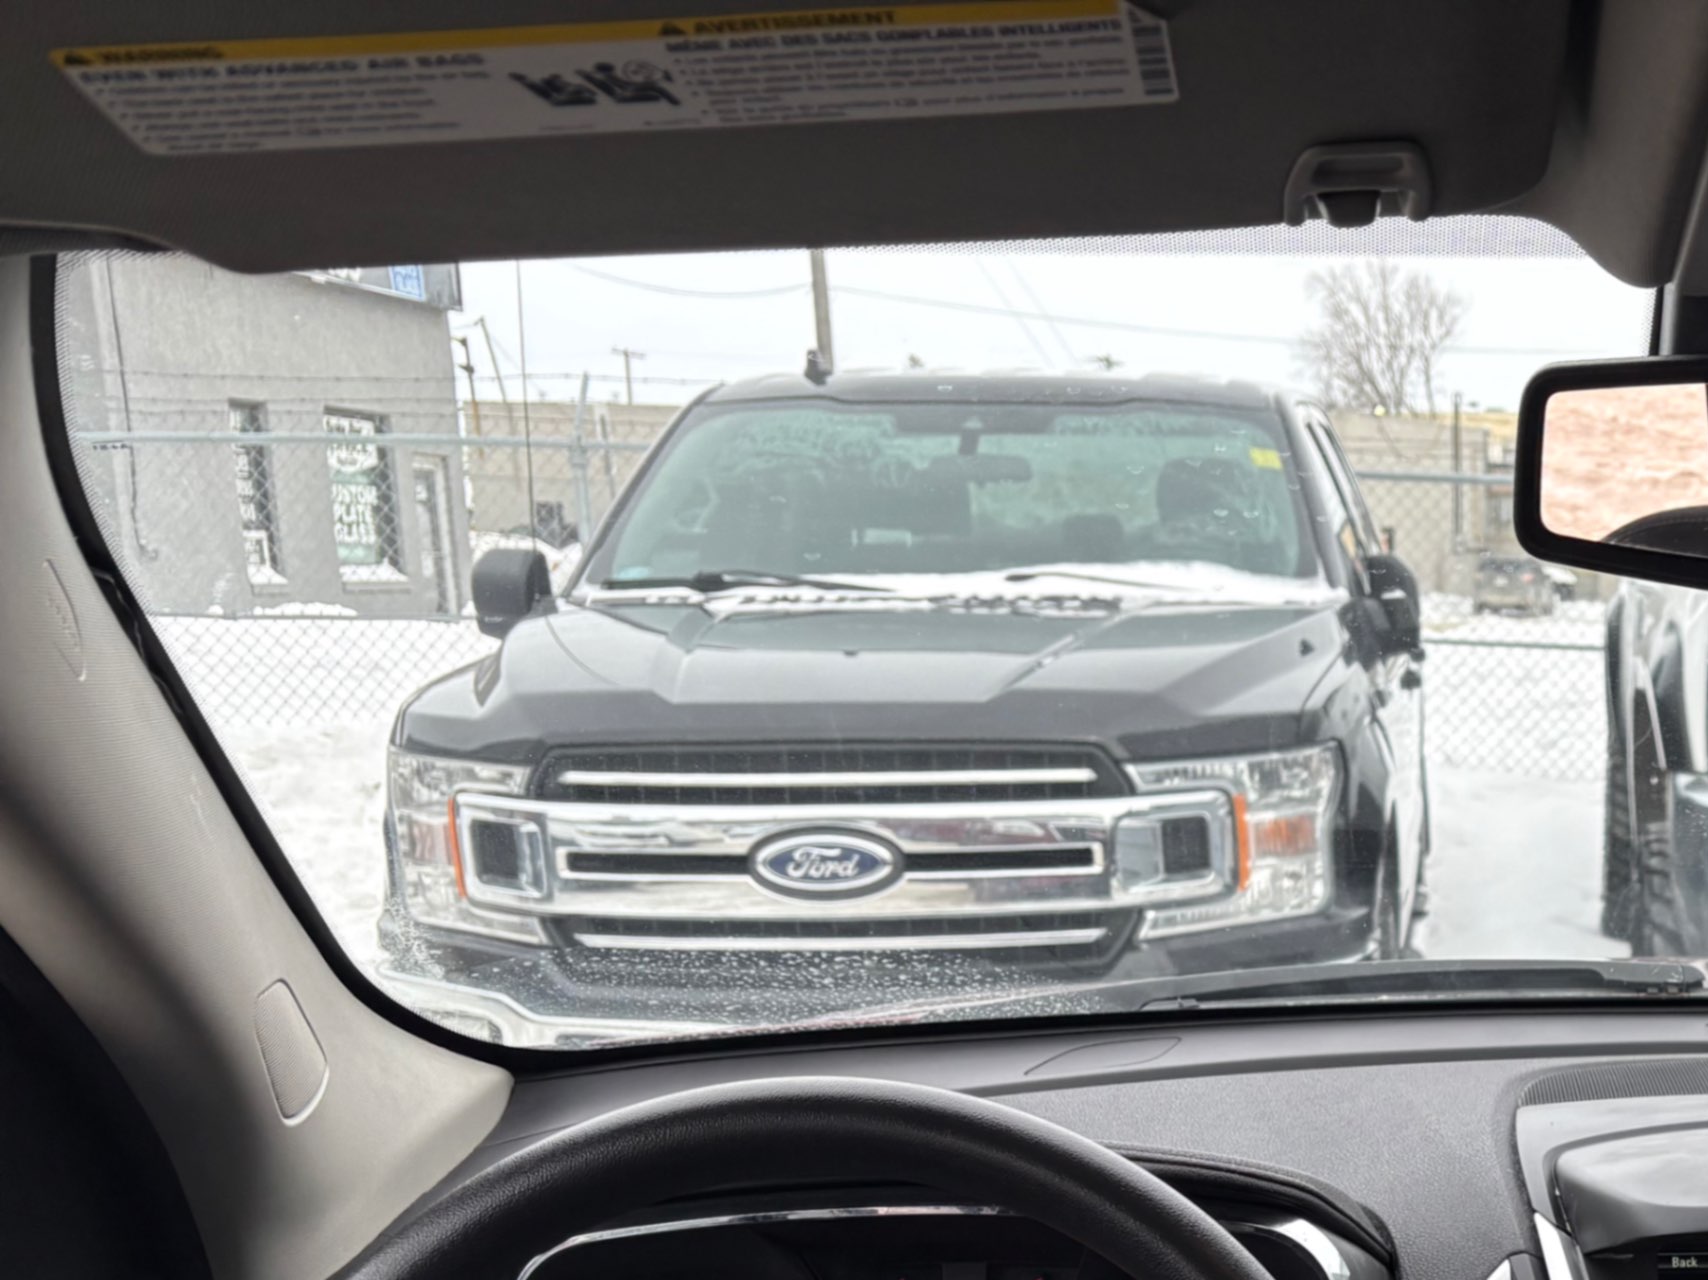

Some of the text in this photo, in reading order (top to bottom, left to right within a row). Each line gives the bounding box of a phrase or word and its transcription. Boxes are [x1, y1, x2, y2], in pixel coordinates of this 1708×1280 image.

[728, 36, 776, 49] AVEC
[780, 34, 818, 46] DES
[821, 30, 870, 43] SACS
[786, 846, 860, 878] Ford
[1671, 1256, 1698, 1268] Back
